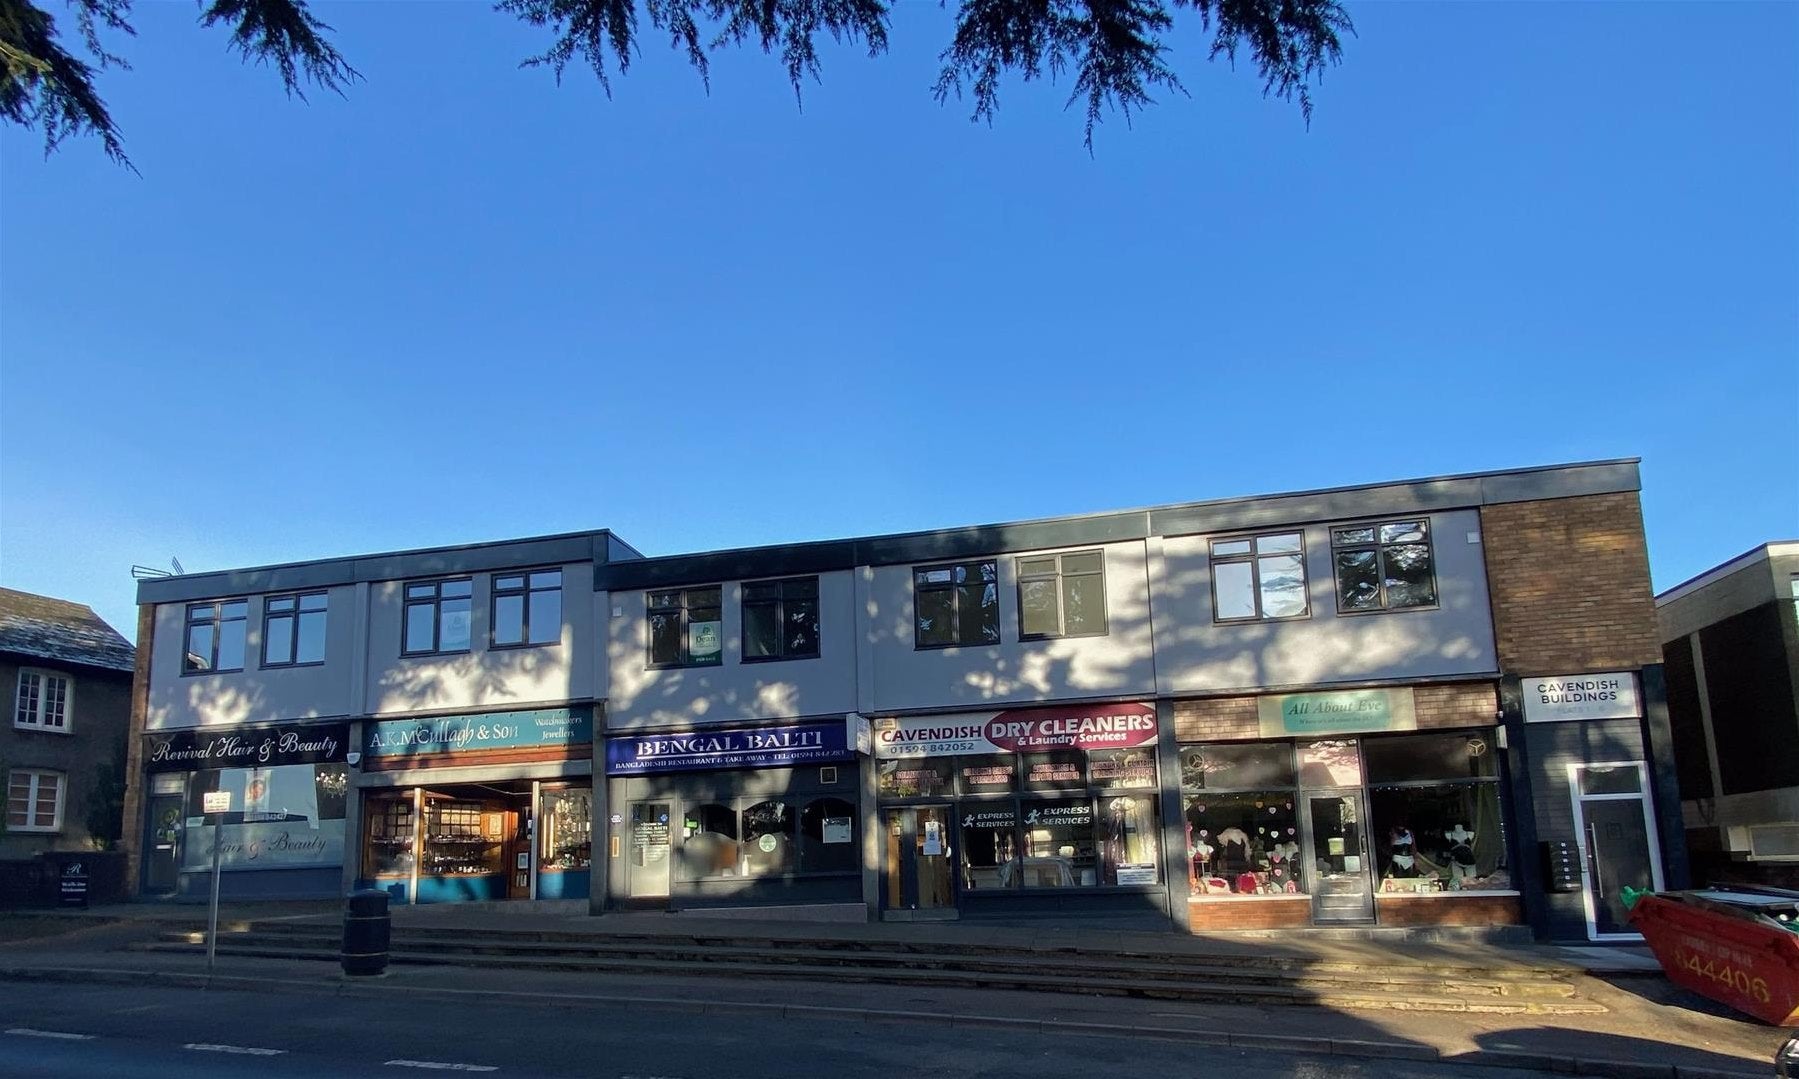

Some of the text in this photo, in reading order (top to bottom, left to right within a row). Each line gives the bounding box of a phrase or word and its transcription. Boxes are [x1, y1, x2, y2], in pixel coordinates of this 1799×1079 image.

[1537, 680, 1619, 693] CAVENDISH
[1541, 691, 1617, 704] BUILDINGS
[1288, 699, 1382, 715] All About Eve
[477, 727, 490, 741] &
[492, 723, 519, 740] Son
[542, 726, 575, 740] Jewellers
[991, 714, 1154, 738] DRY CLEANERS
[881, 725, 982, 742] CAVENDISH
[1017, 732, 1127, 746] & Laundry Services
[152, 732, 338, 762] Revival Hair & Beauty
[637, 731, 823, 756] BENGAL BALTI
[890, 742, 975, 754] 01594 842052
[977, 811, 1015, 820] EXPRESS
[1043, 806, 1090, 815] EXPRESS
[976, 820, 1015, 828] SERVICES
[1042, 816, 1091, 825] SERVICES
[267, 831, 327, 856] Beauty
